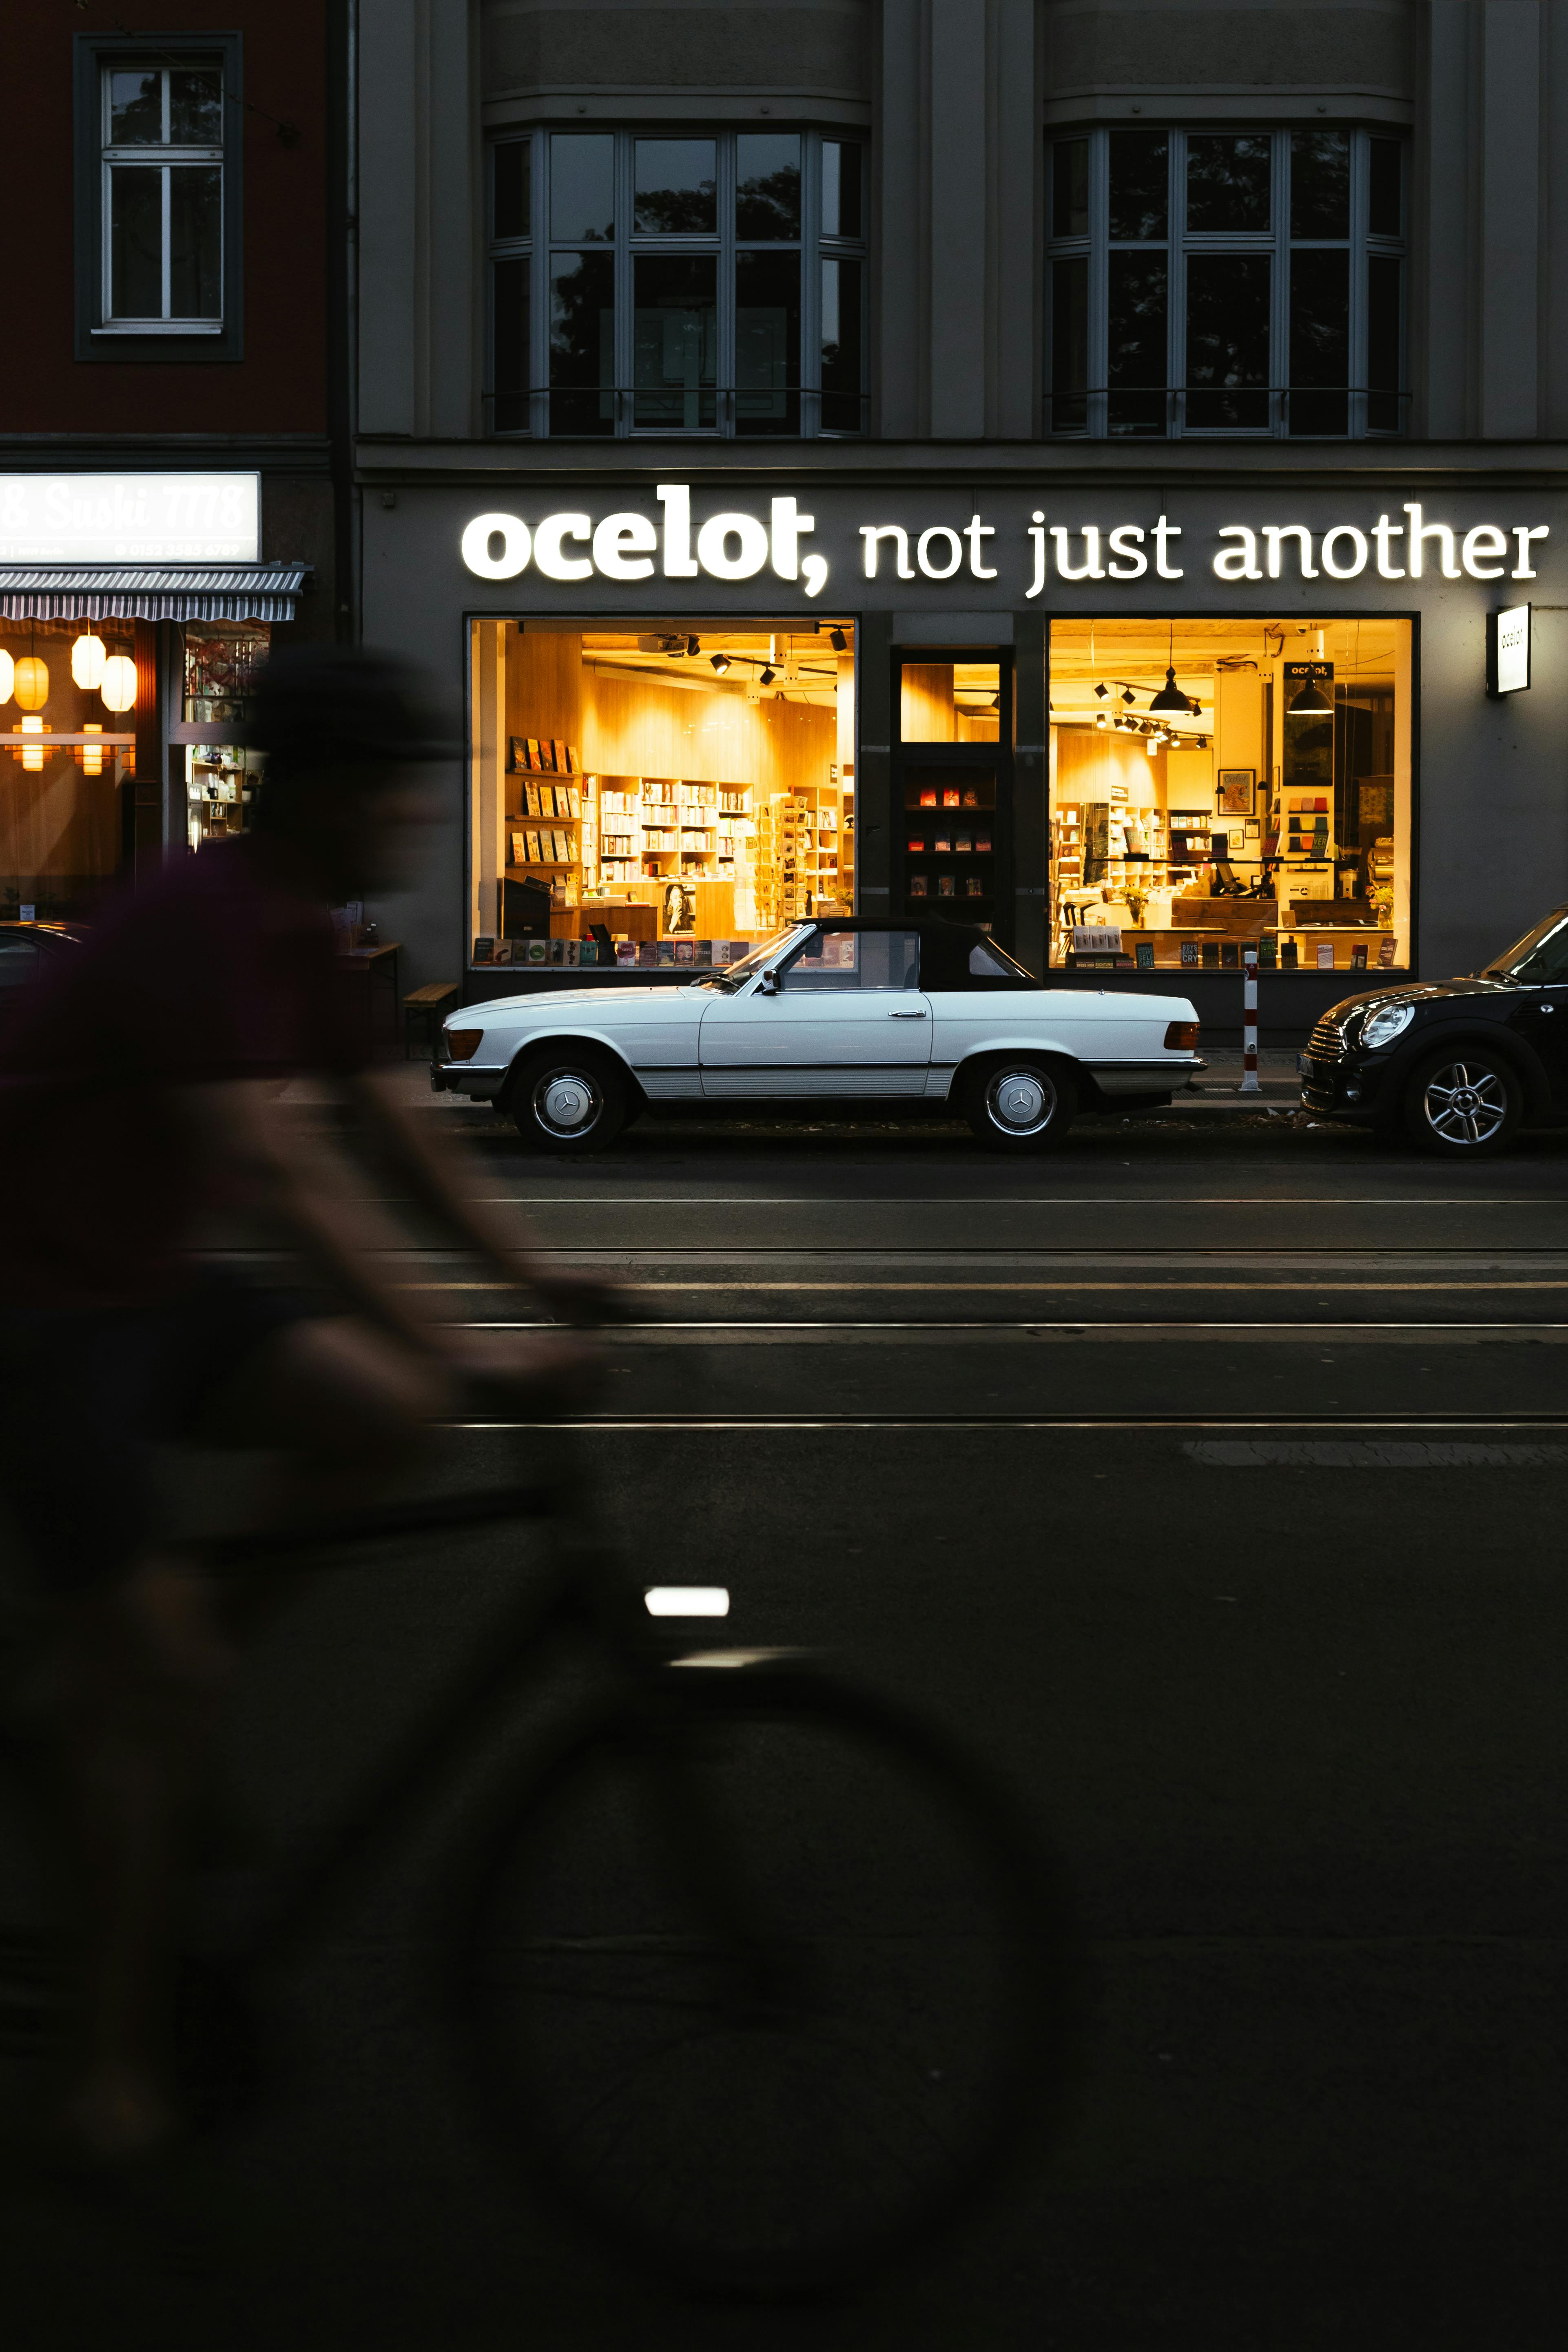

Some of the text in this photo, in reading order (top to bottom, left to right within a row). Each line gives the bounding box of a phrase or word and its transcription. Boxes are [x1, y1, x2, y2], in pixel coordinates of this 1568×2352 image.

[44, 482, 151, 530] Sushi
[163, 484, 245, 529] 7778
[130, 543, 240, 556] 0152 3585 6789
[461, 484, 1549, 598] ocelot, not just another
